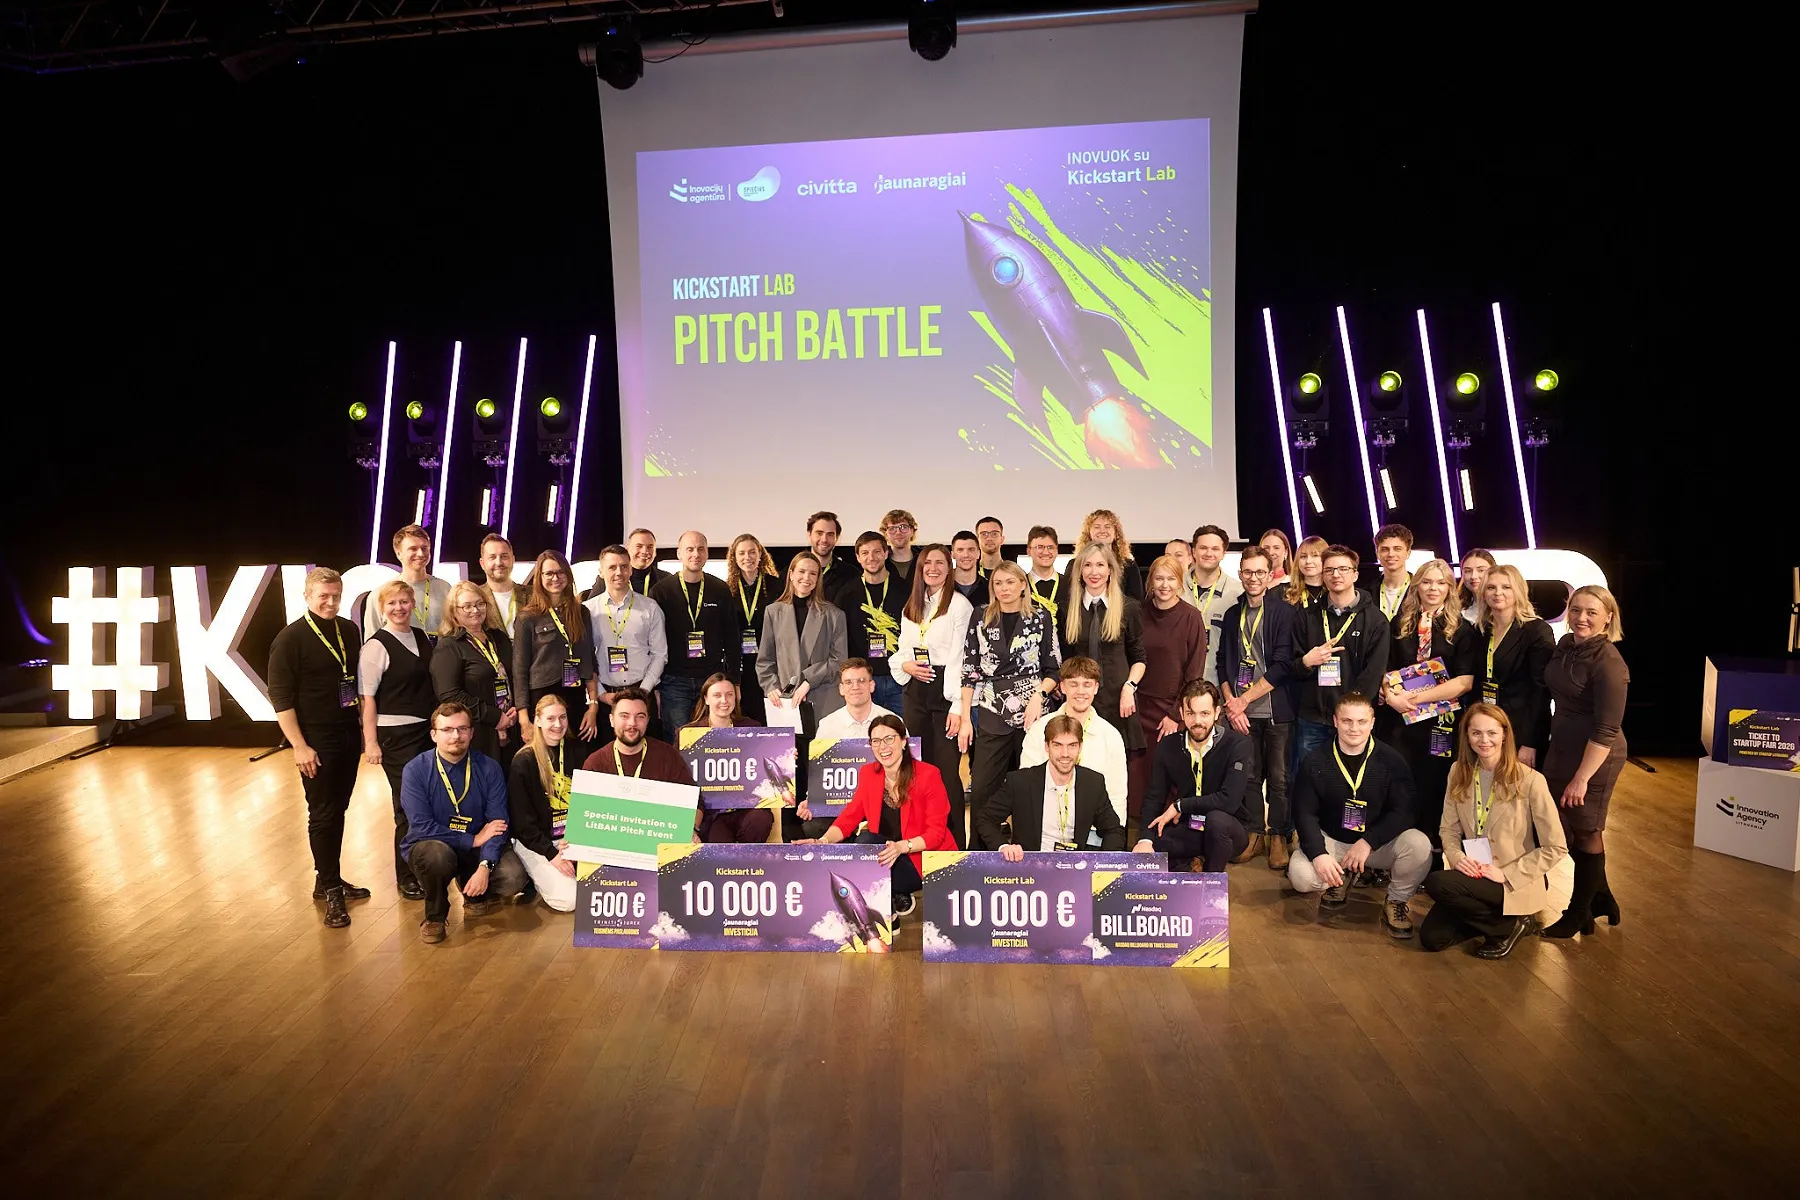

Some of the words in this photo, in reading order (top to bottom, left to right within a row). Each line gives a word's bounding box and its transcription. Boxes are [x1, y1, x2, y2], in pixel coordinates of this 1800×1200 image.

[1068, 149, 1130, 164] INOVUOK
[1134, 152, 1150, 161] su
[874, 172, 966, 194] jaunaragiai
[1068, 168, 1141, 185] Kickstart
[1146, 166, 1176, 181] Lab
[797, 179, 857, 196] civitta
[673, 274, 760, 300] KICKSTART
[764, 273, 795, 296] LAB
[675, 311, 783, 364] PITCH
[796, 305, 942, 360] BATTLE
[1733, 739, 1761, 747] STARTUP
[1748, 732, 1770, 740] TICKET
[690, 759, 698, 782] 1
[705, 758, 740, 781] 000
[745, 758, 757, 780] €
[822, 768, 857, 790] 500
[584, 810, 618, 820] Special
[620, 815, 665, 827] Invitation
[1737, 804, 1779, 819] Innovation
[1737, 812, 1767, 826] Agency
[586, 821, 617, 832] LitBAN
[620, 826, 644, 835] Pitch
[647, 830, 673, 839] Event
[984, 876, 1019, 884] Kickstart
[590, 892, 628, 917] 500
[633, 892, 645, 918] €
[682, 881, 714, 916] 10
[722, 881, 777, 917] 000
[785, 881, 803, 916] €
[948, 890, 982, 926] 10
[990, 890, 1048, 927] 000
[1057, 890, 1075, 927] €
[1100, 915, 1192, 937] BILLBOARD
